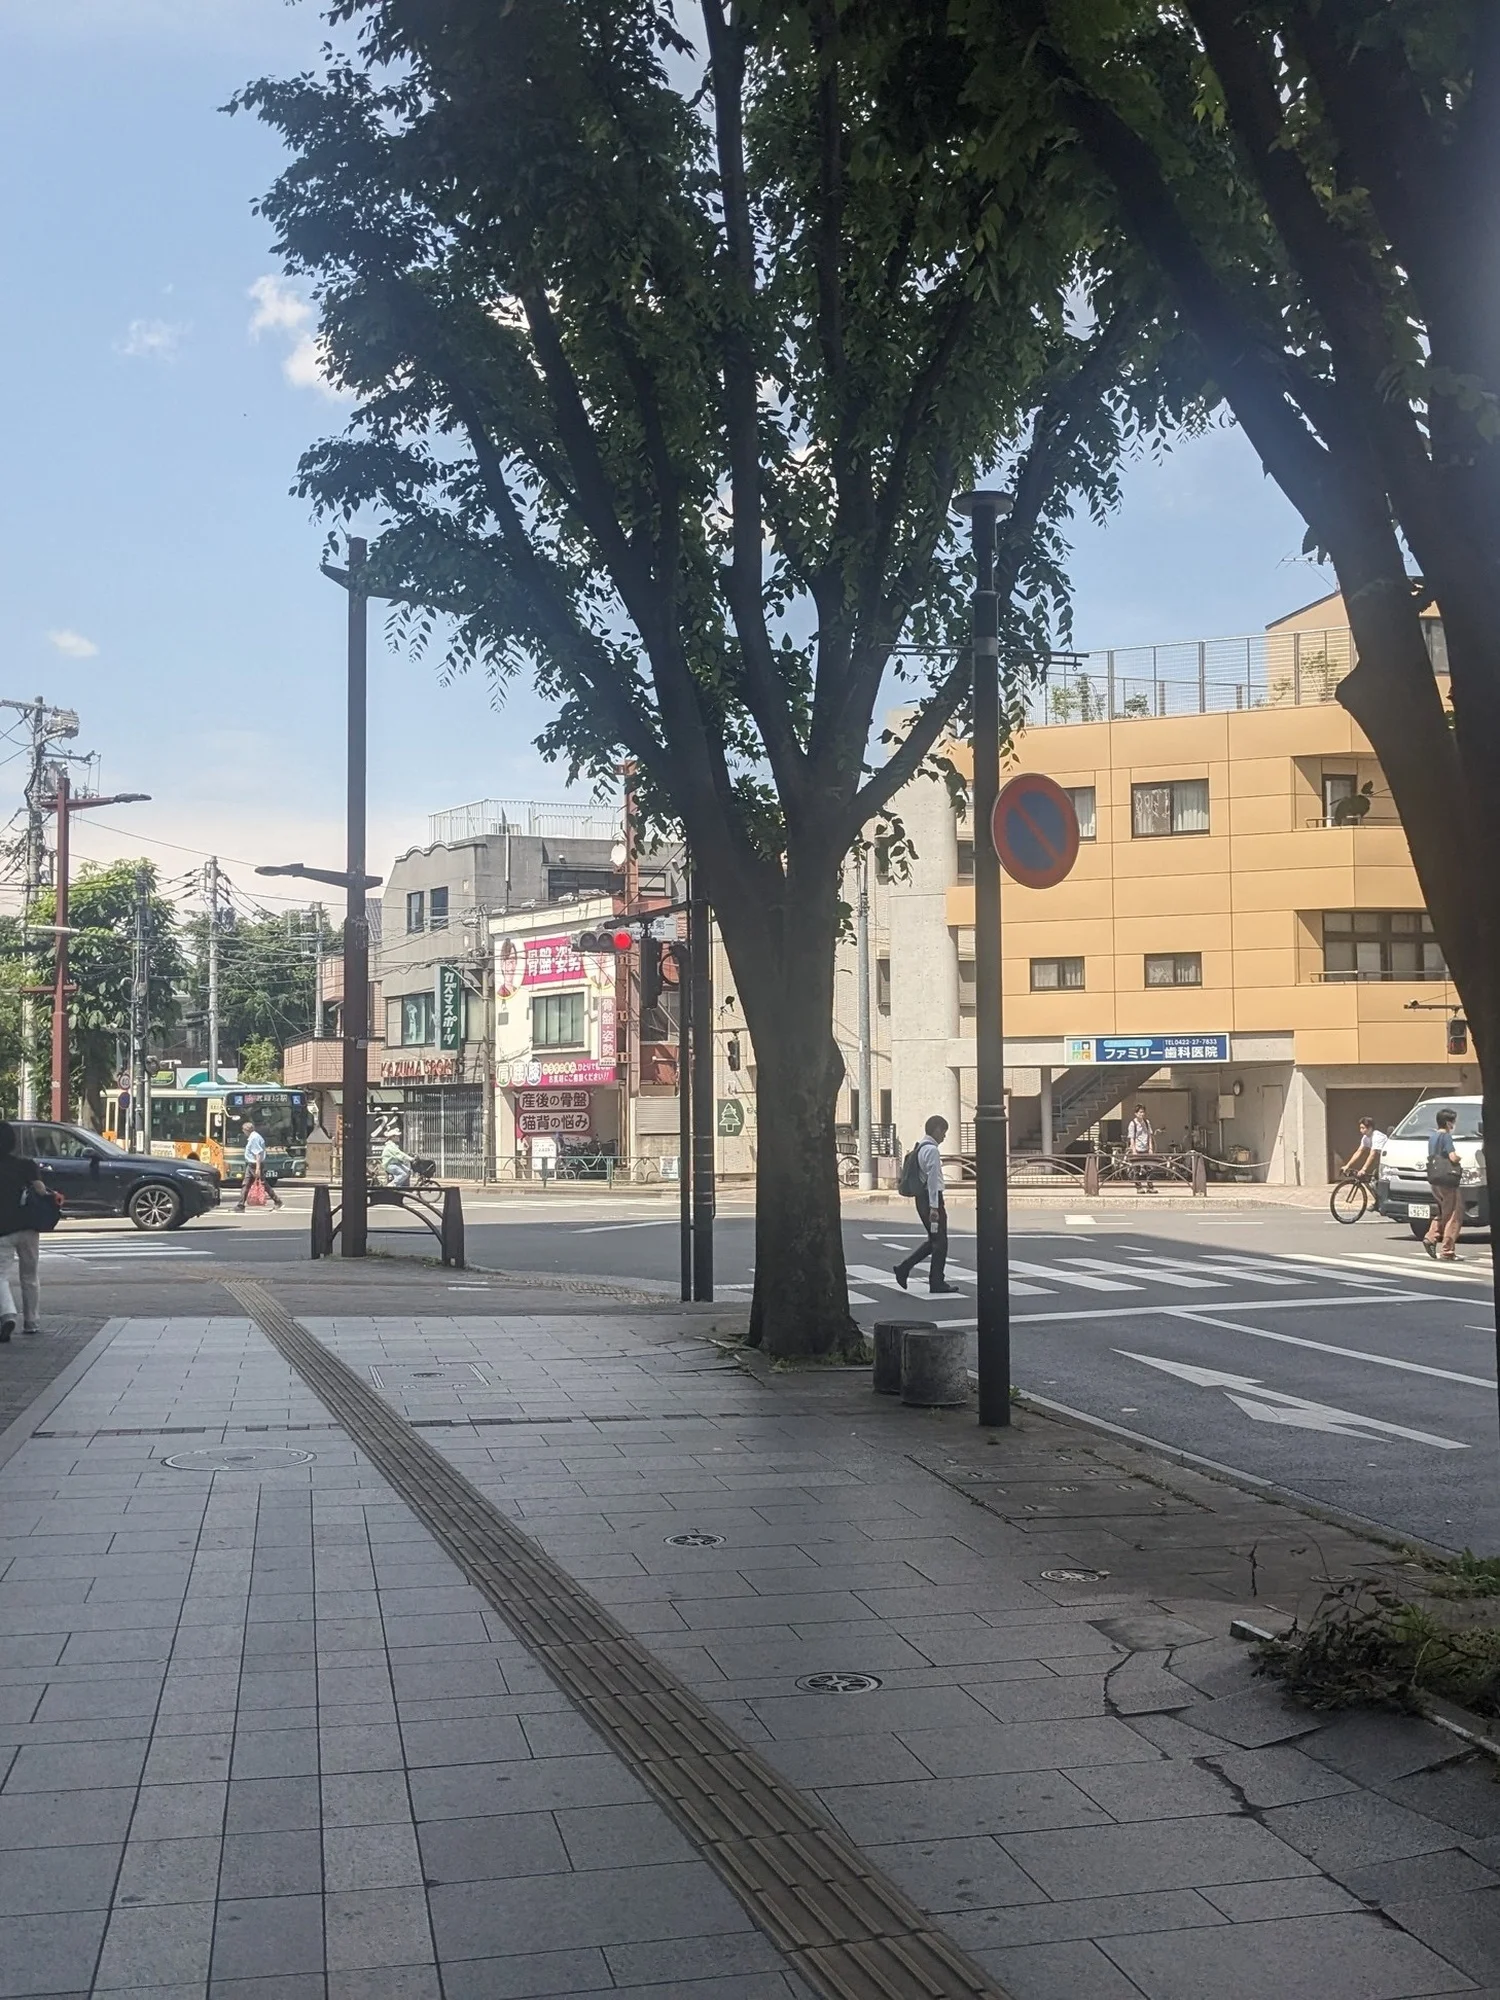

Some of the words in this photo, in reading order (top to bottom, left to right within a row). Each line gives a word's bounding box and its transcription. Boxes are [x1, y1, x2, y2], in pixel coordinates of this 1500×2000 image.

[443, 971, 458, 1045] カズマスポーツ
[381, 1060, 425, 1077] KAZUMA
[425, 1057, 465, 1075] SPORTS
[522, 1092, 587, 1108] 産後の骨盤
[522, 1114, 588, 1130] 猫背の悩み
